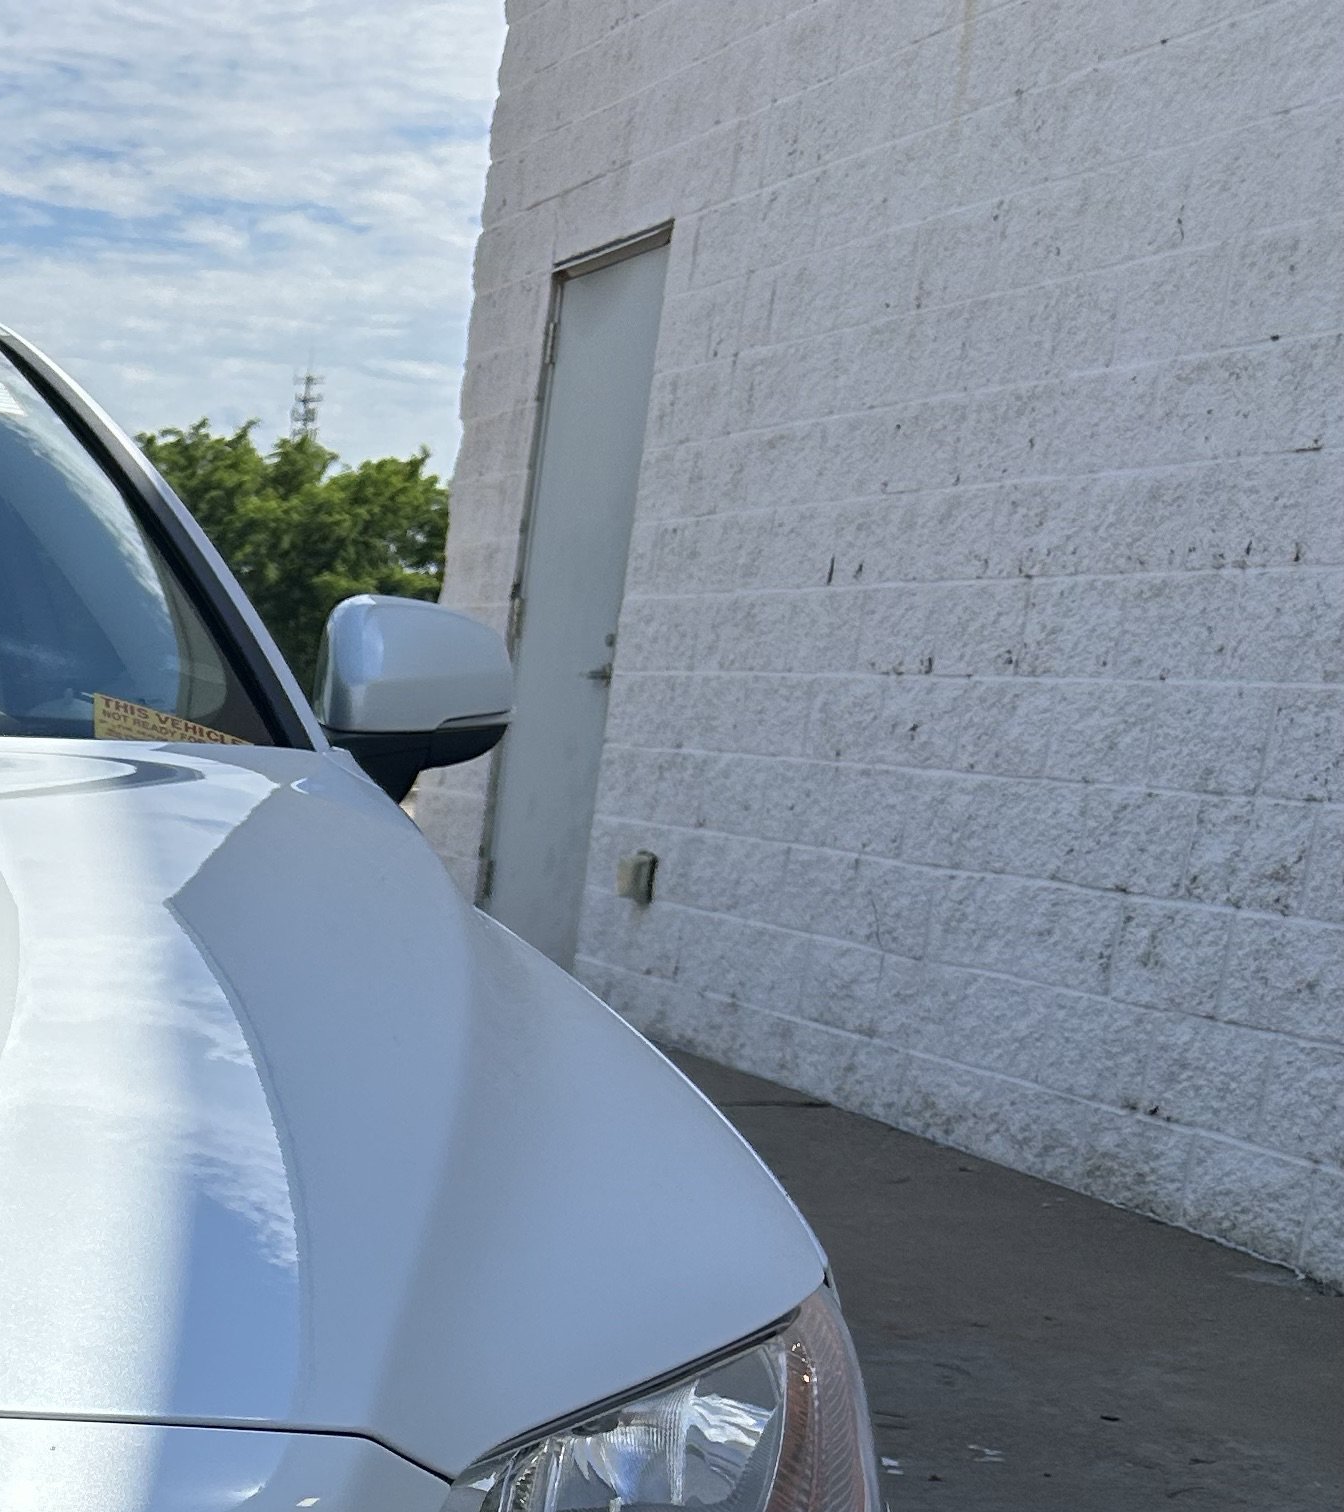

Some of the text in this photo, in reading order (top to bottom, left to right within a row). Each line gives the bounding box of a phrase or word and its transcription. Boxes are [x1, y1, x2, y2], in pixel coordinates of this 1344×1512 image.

[100, 696, 150, 720] THIS
[101, 709, 128, 723] NOT
[133, 717, 176, 739] READY
